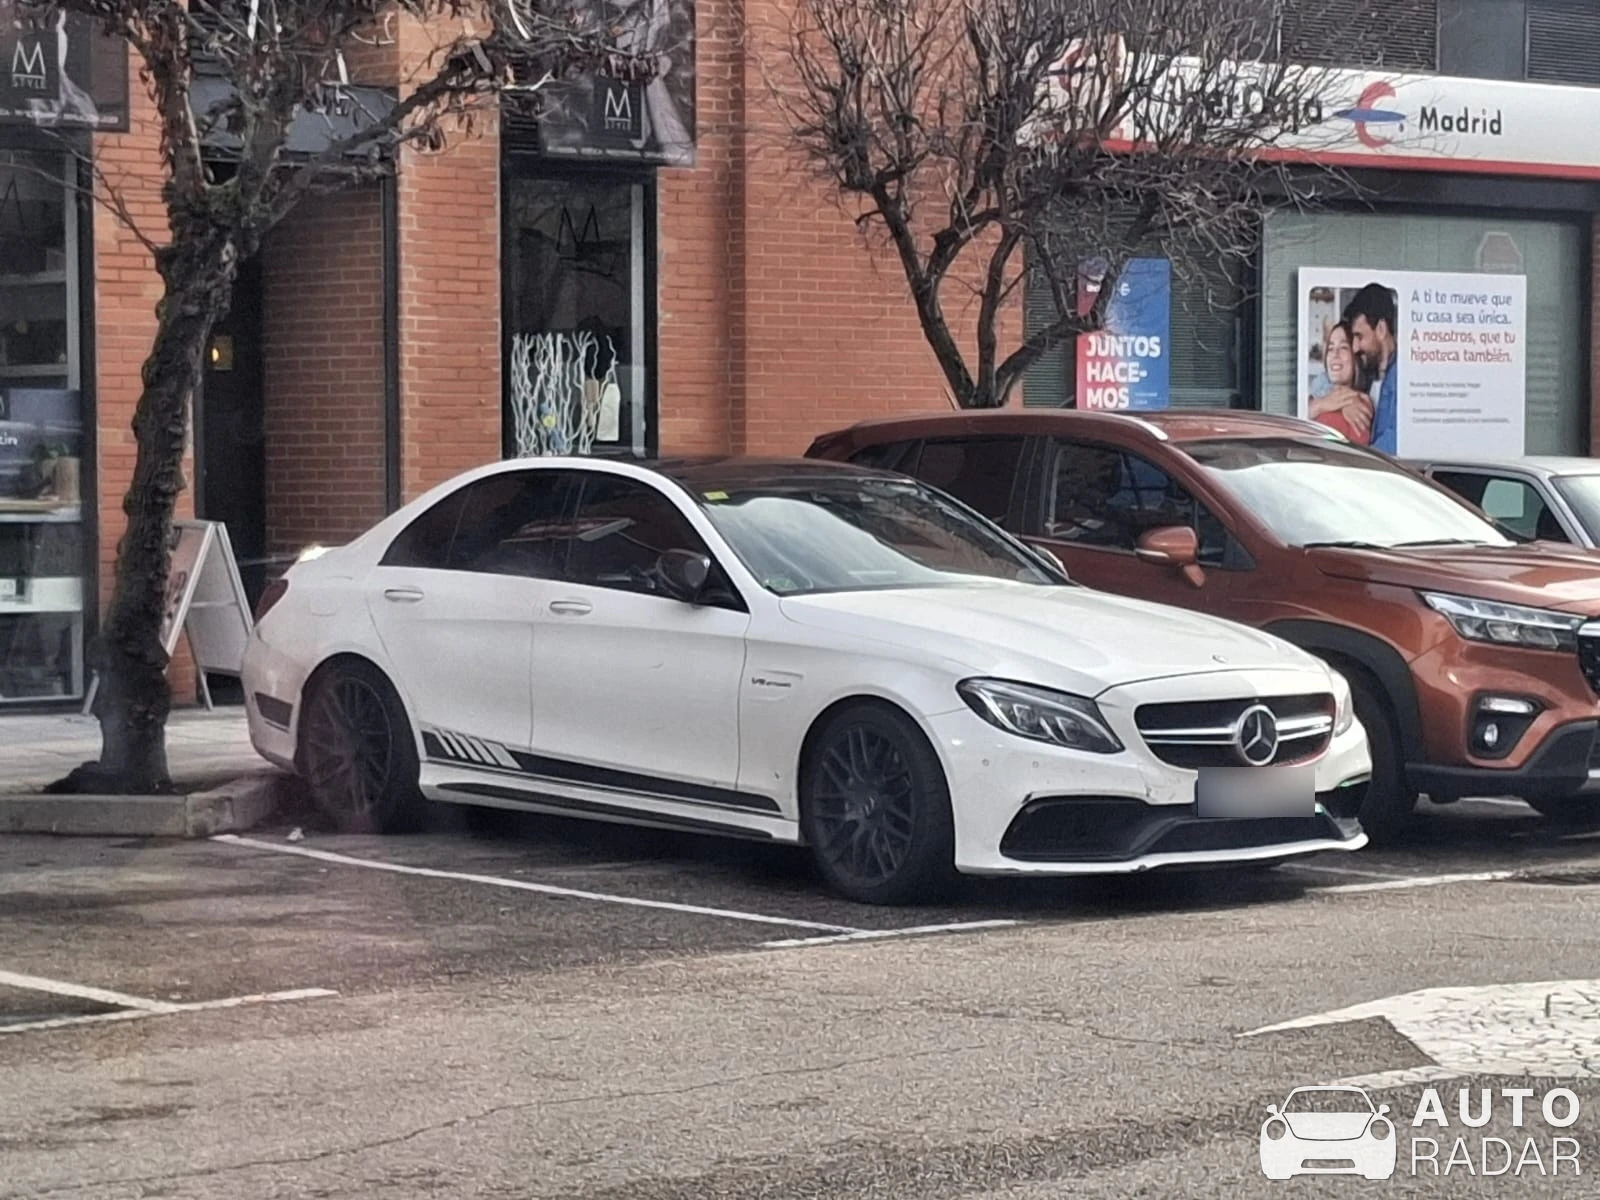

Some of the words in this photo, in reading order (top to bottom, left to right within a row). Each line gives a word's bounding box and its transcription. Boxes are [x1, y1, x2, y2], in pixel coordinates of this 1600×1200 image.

[12, 40, 46, 74] M
[604, 87, 632, 118] M
[1419, 106, 1502, 136] Madrid
[1411, 289, 1420, 303] A
[1424, 289, 1432, 304] ti
[1435, 290, 1447, 305] te
[1450, 293, 1488, 306] mueve
[1491, 294, 1512, 308] que
[1411, 309, 1423, 323] tu
[1426, 311, 1452, 323] casa
[1456, 312, 1475, 324] sea
[1086, 335, 1161, 358] JUNTOS
[1411, 327, 1420, 342] A
[1423, 329, 1476, 344] nosotros,
[1480, 331, 1501, 345] que
[1504, 331, 1516, 344] tu
[1410, 346, 1460, 364] hipoteca
[1086, 361, 1148, 383] HACE-
[1086, 387, 1130, 409] MOS
